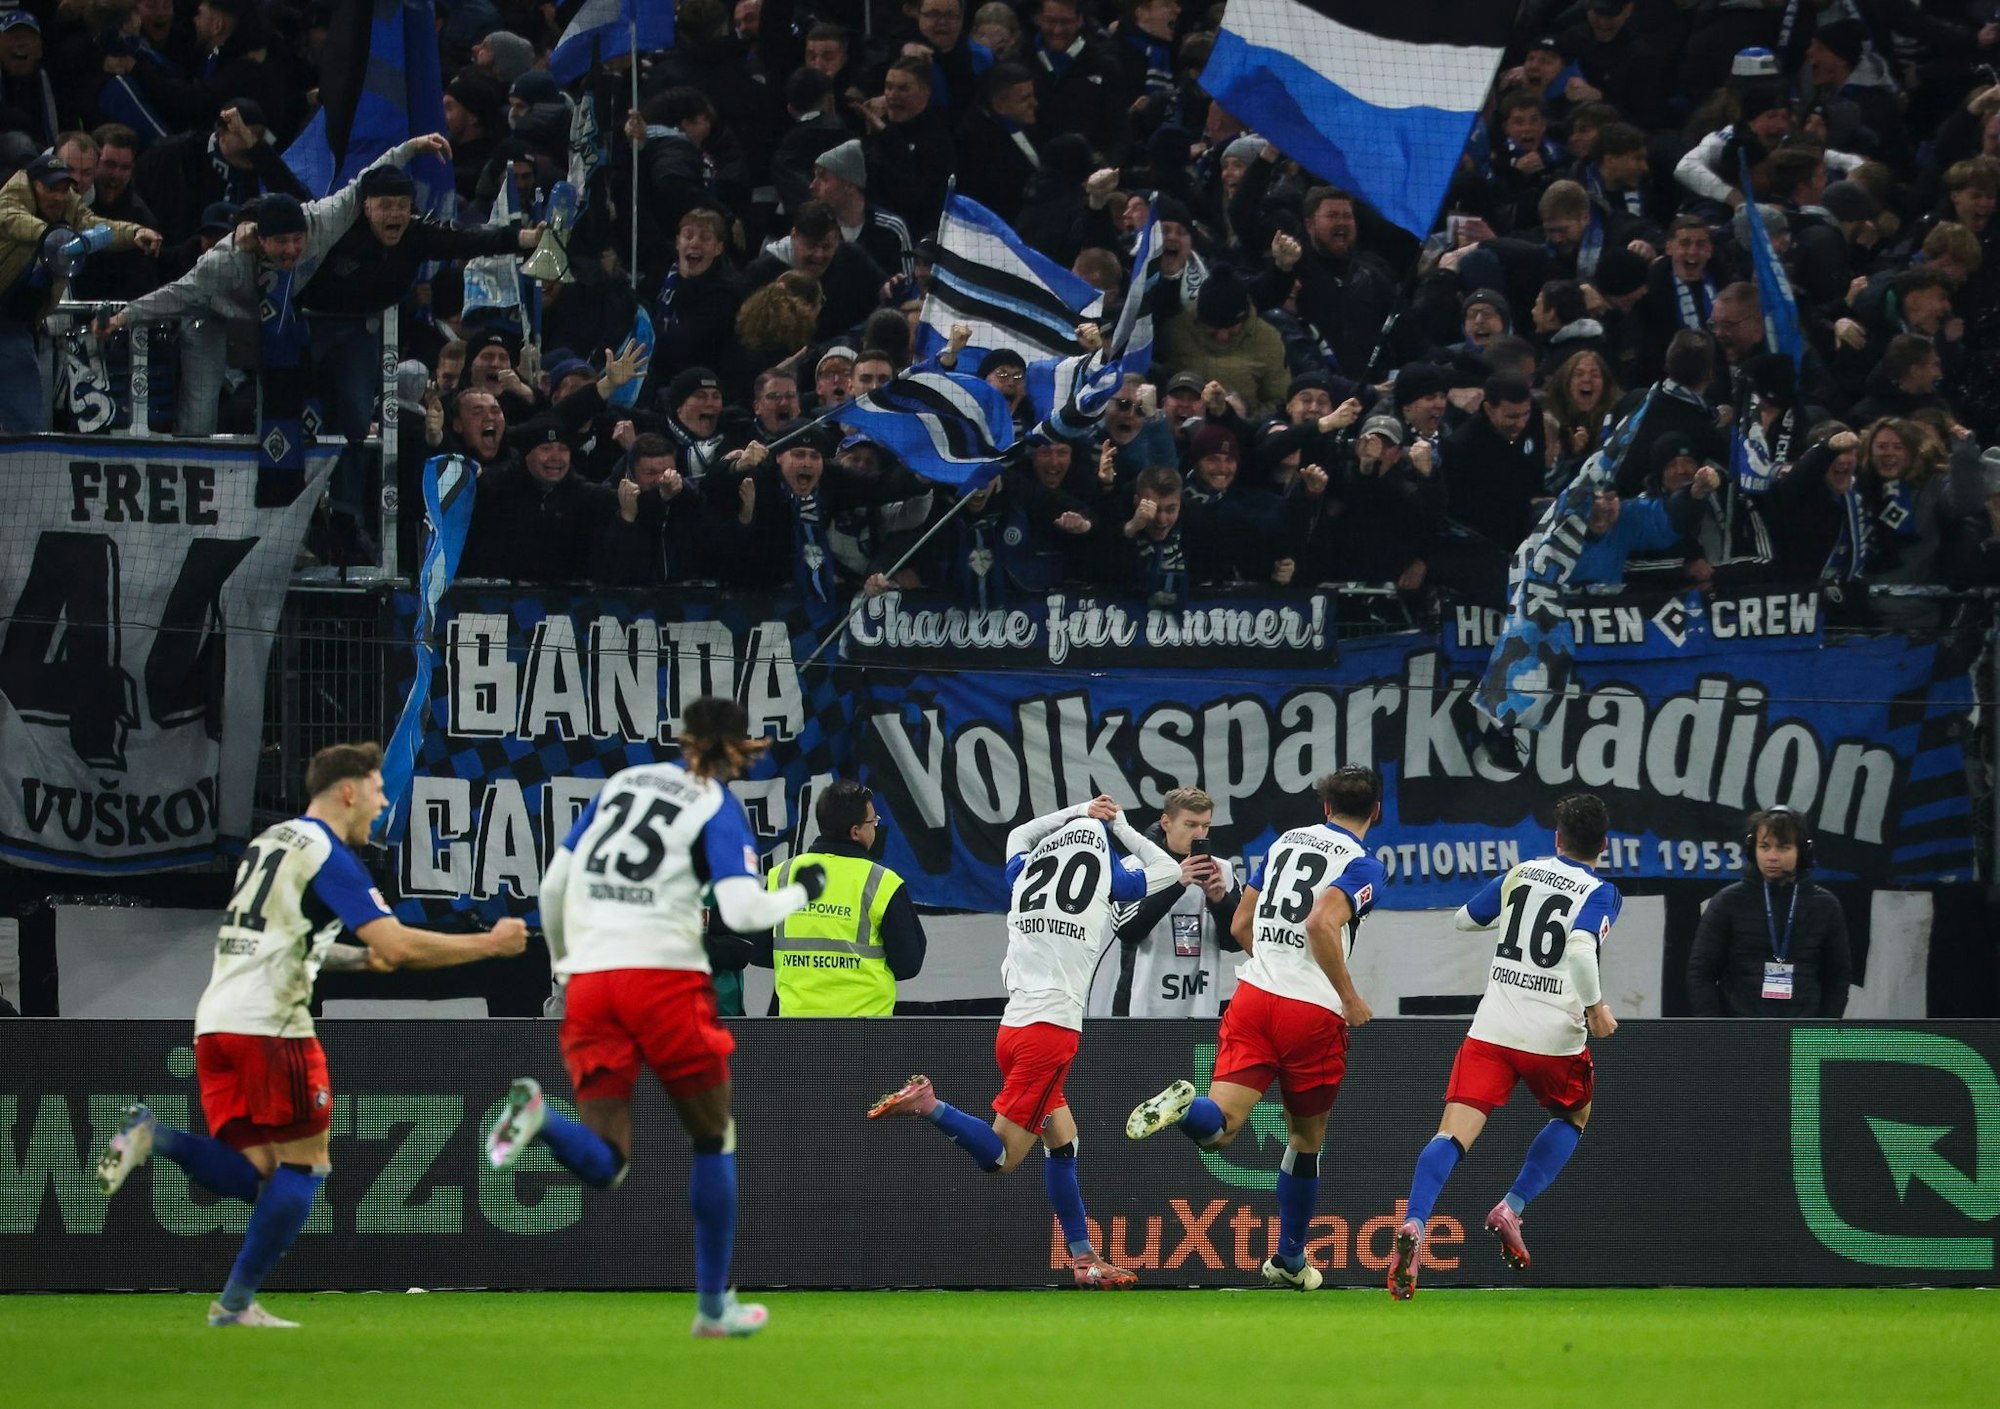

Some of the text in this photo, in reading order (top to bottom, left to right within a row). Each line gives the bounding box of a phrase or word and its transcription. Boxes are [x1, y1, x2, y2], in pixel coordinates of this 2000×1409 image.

[69, 462, 218, 525] FREE
[1046, 594, 1138, 664] für
[1456, 592, 1818, 647] HOTEN CREW
[445, 613, 805, 746] BANDA
[586, 792, 682, 882] 25
[1657, 840, 1742, 871] 1953
[222, 846, 287, 932] 21
[1019, 851, 1101, 915] 20
[1259, 848, 1328, 924] 13
[1047, 918, 1086, 941] VIEIRA
[1258, 926, 1305, 949] AMOS
[1495, 884, 1574, 969] 16
[813, 955, 861, 969] SECURITY
